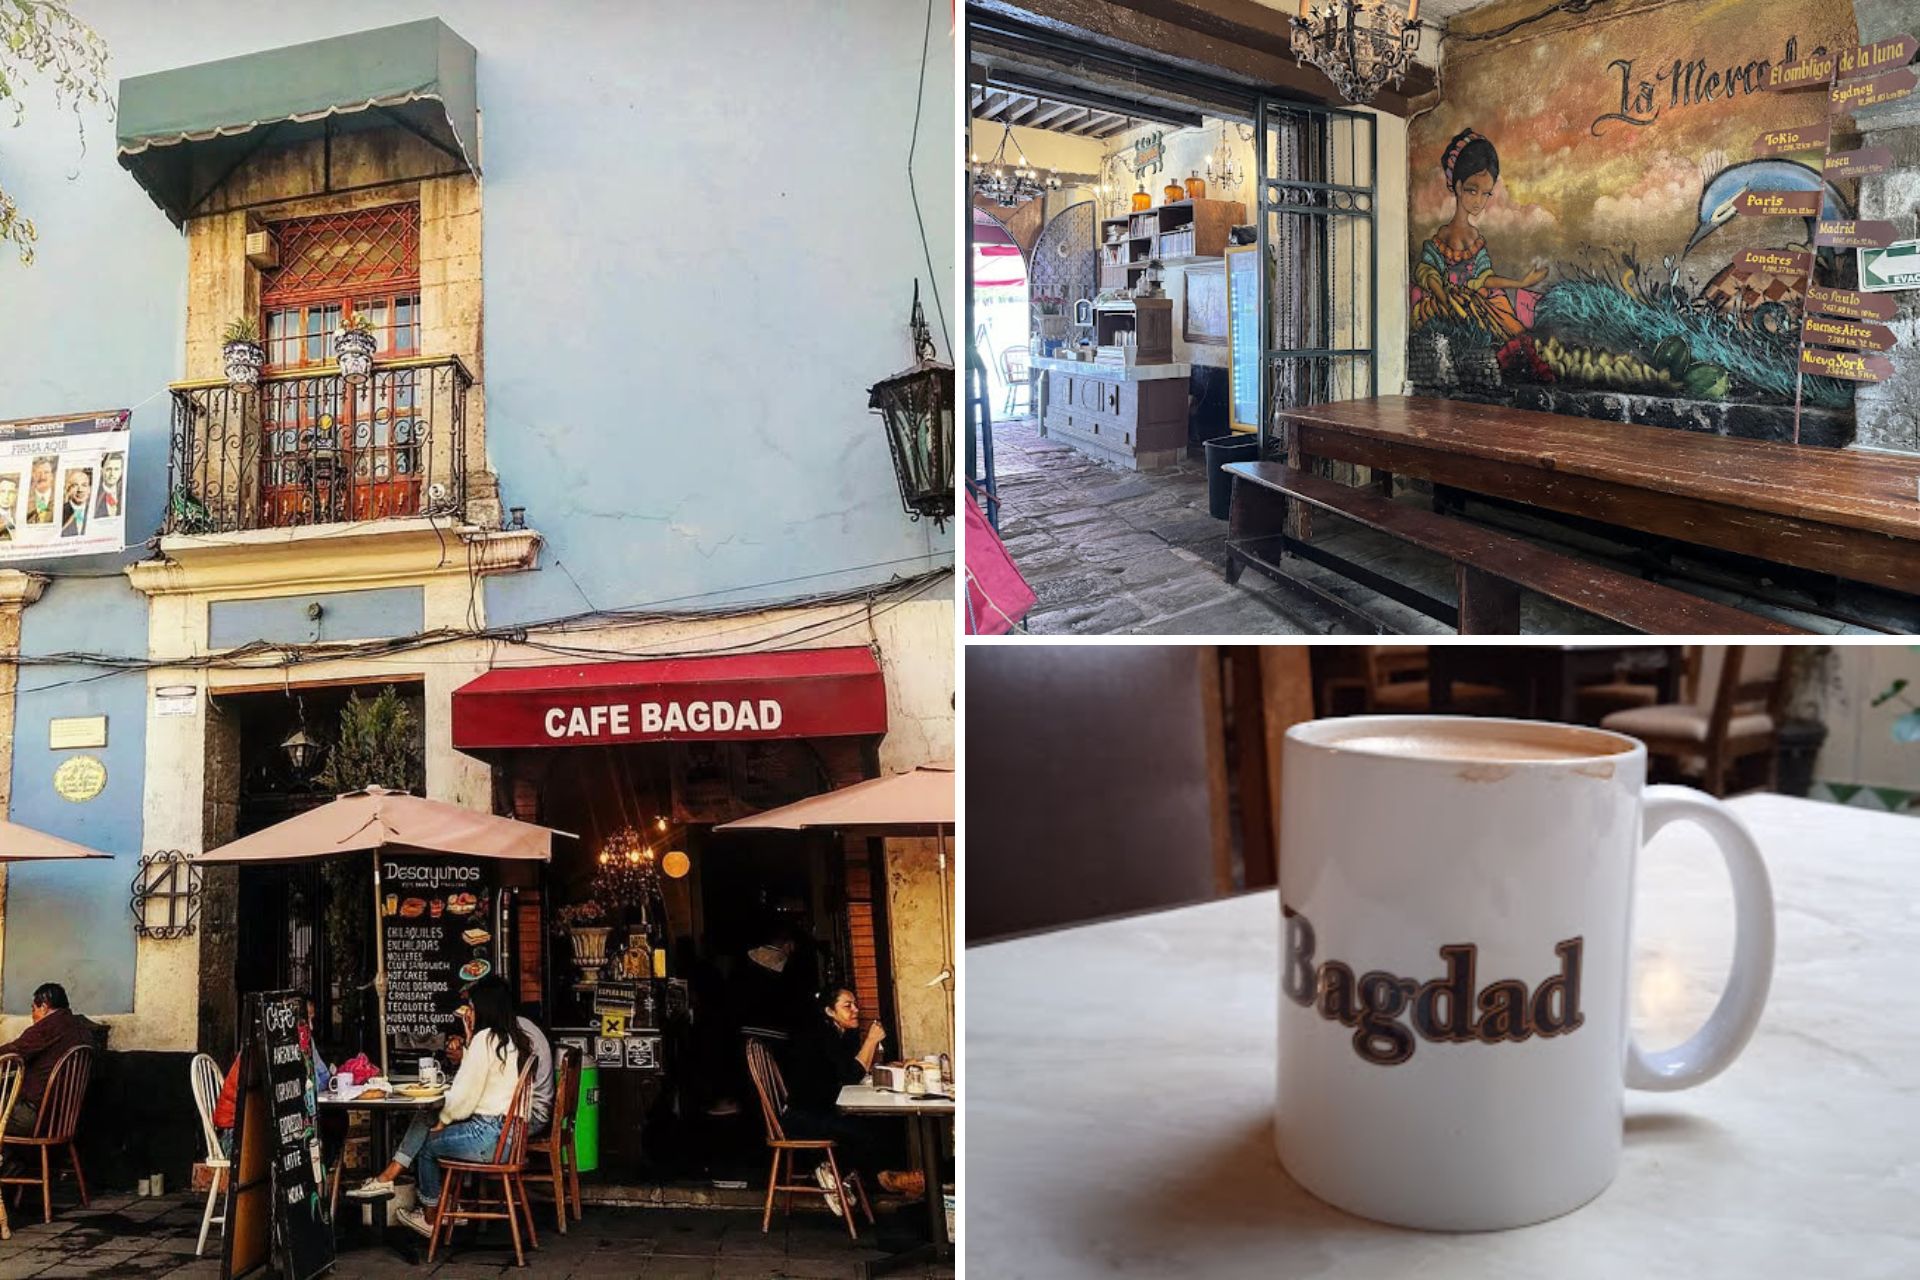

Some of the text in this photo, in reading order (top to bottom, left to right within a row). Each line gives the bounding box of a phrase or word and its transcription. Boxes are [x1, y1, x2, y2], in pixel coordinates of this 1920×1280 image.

[1769, 43, 1904, 85] El ombligo de la luna
[1832, 84, 1873, 103] Sydney
[1747, 194, 1784, 206] Paris
[1818, 222, 1856, 234] Madrid
[1745, 253, 1793, 266] Londres
[1841, 324, 1872, 338] Aires
[1803, 350, 1835, 367] Nueva
[544, 700, 782, 738] CAFE BAGDAD
[384, 863, 480, 888] Desayunos
[1283, 906, 1585, 1066] Bagdad
